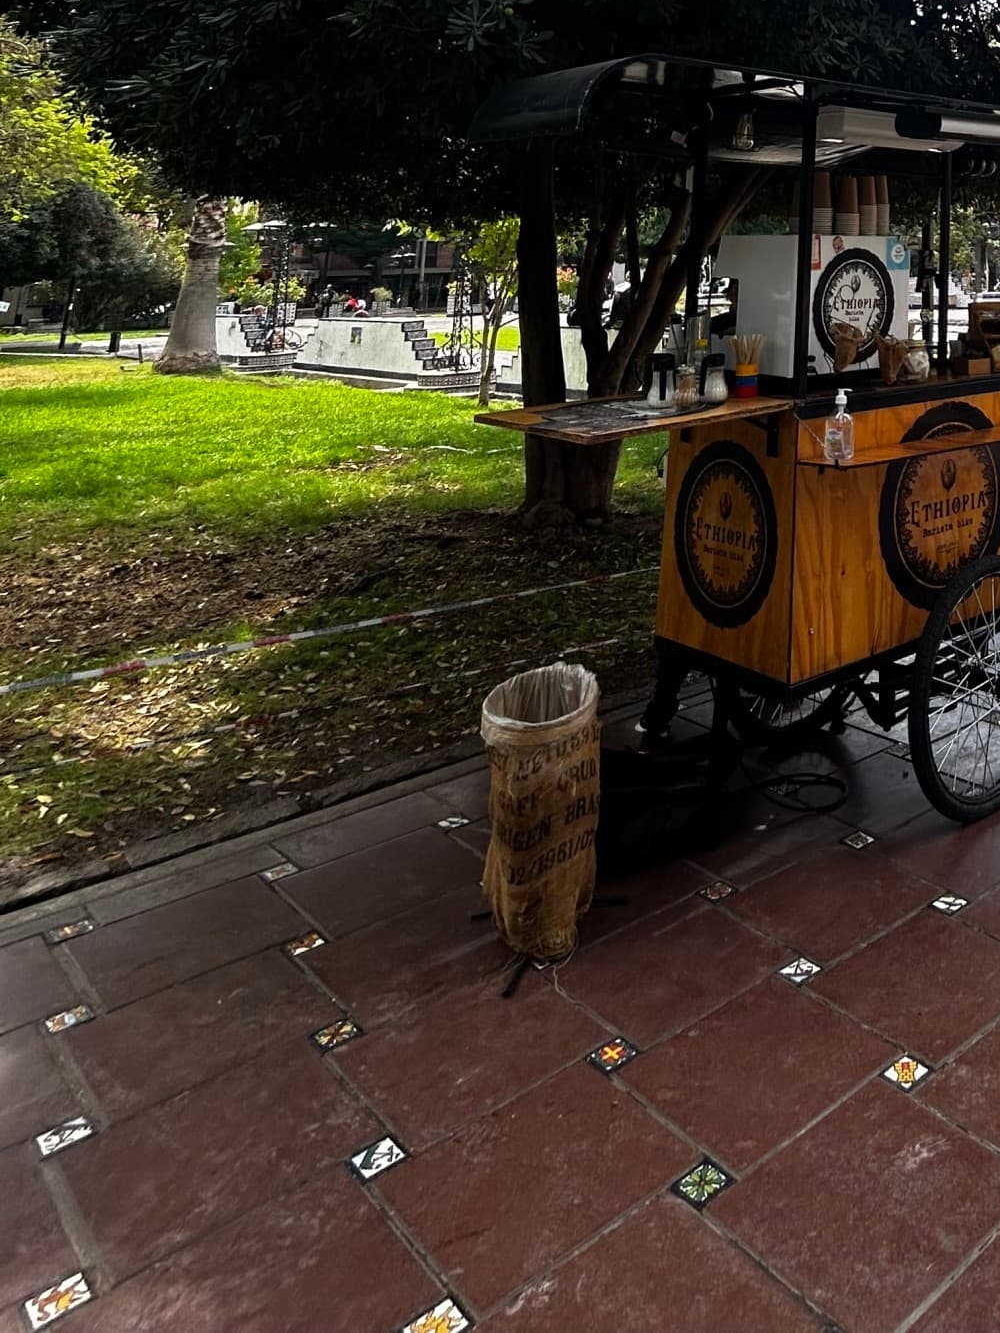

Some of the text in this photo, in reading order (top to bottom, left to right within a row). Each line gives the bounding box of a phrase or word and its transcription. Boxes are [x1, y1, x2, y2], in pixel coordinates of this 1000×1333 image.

[910, 490, 986, 528] ETHIOPIA
[696, 516, 757, 551] ETHIOPIA
[921, 523, 953, 538] Barista
[495, 814, 553, 851] RIGEN
